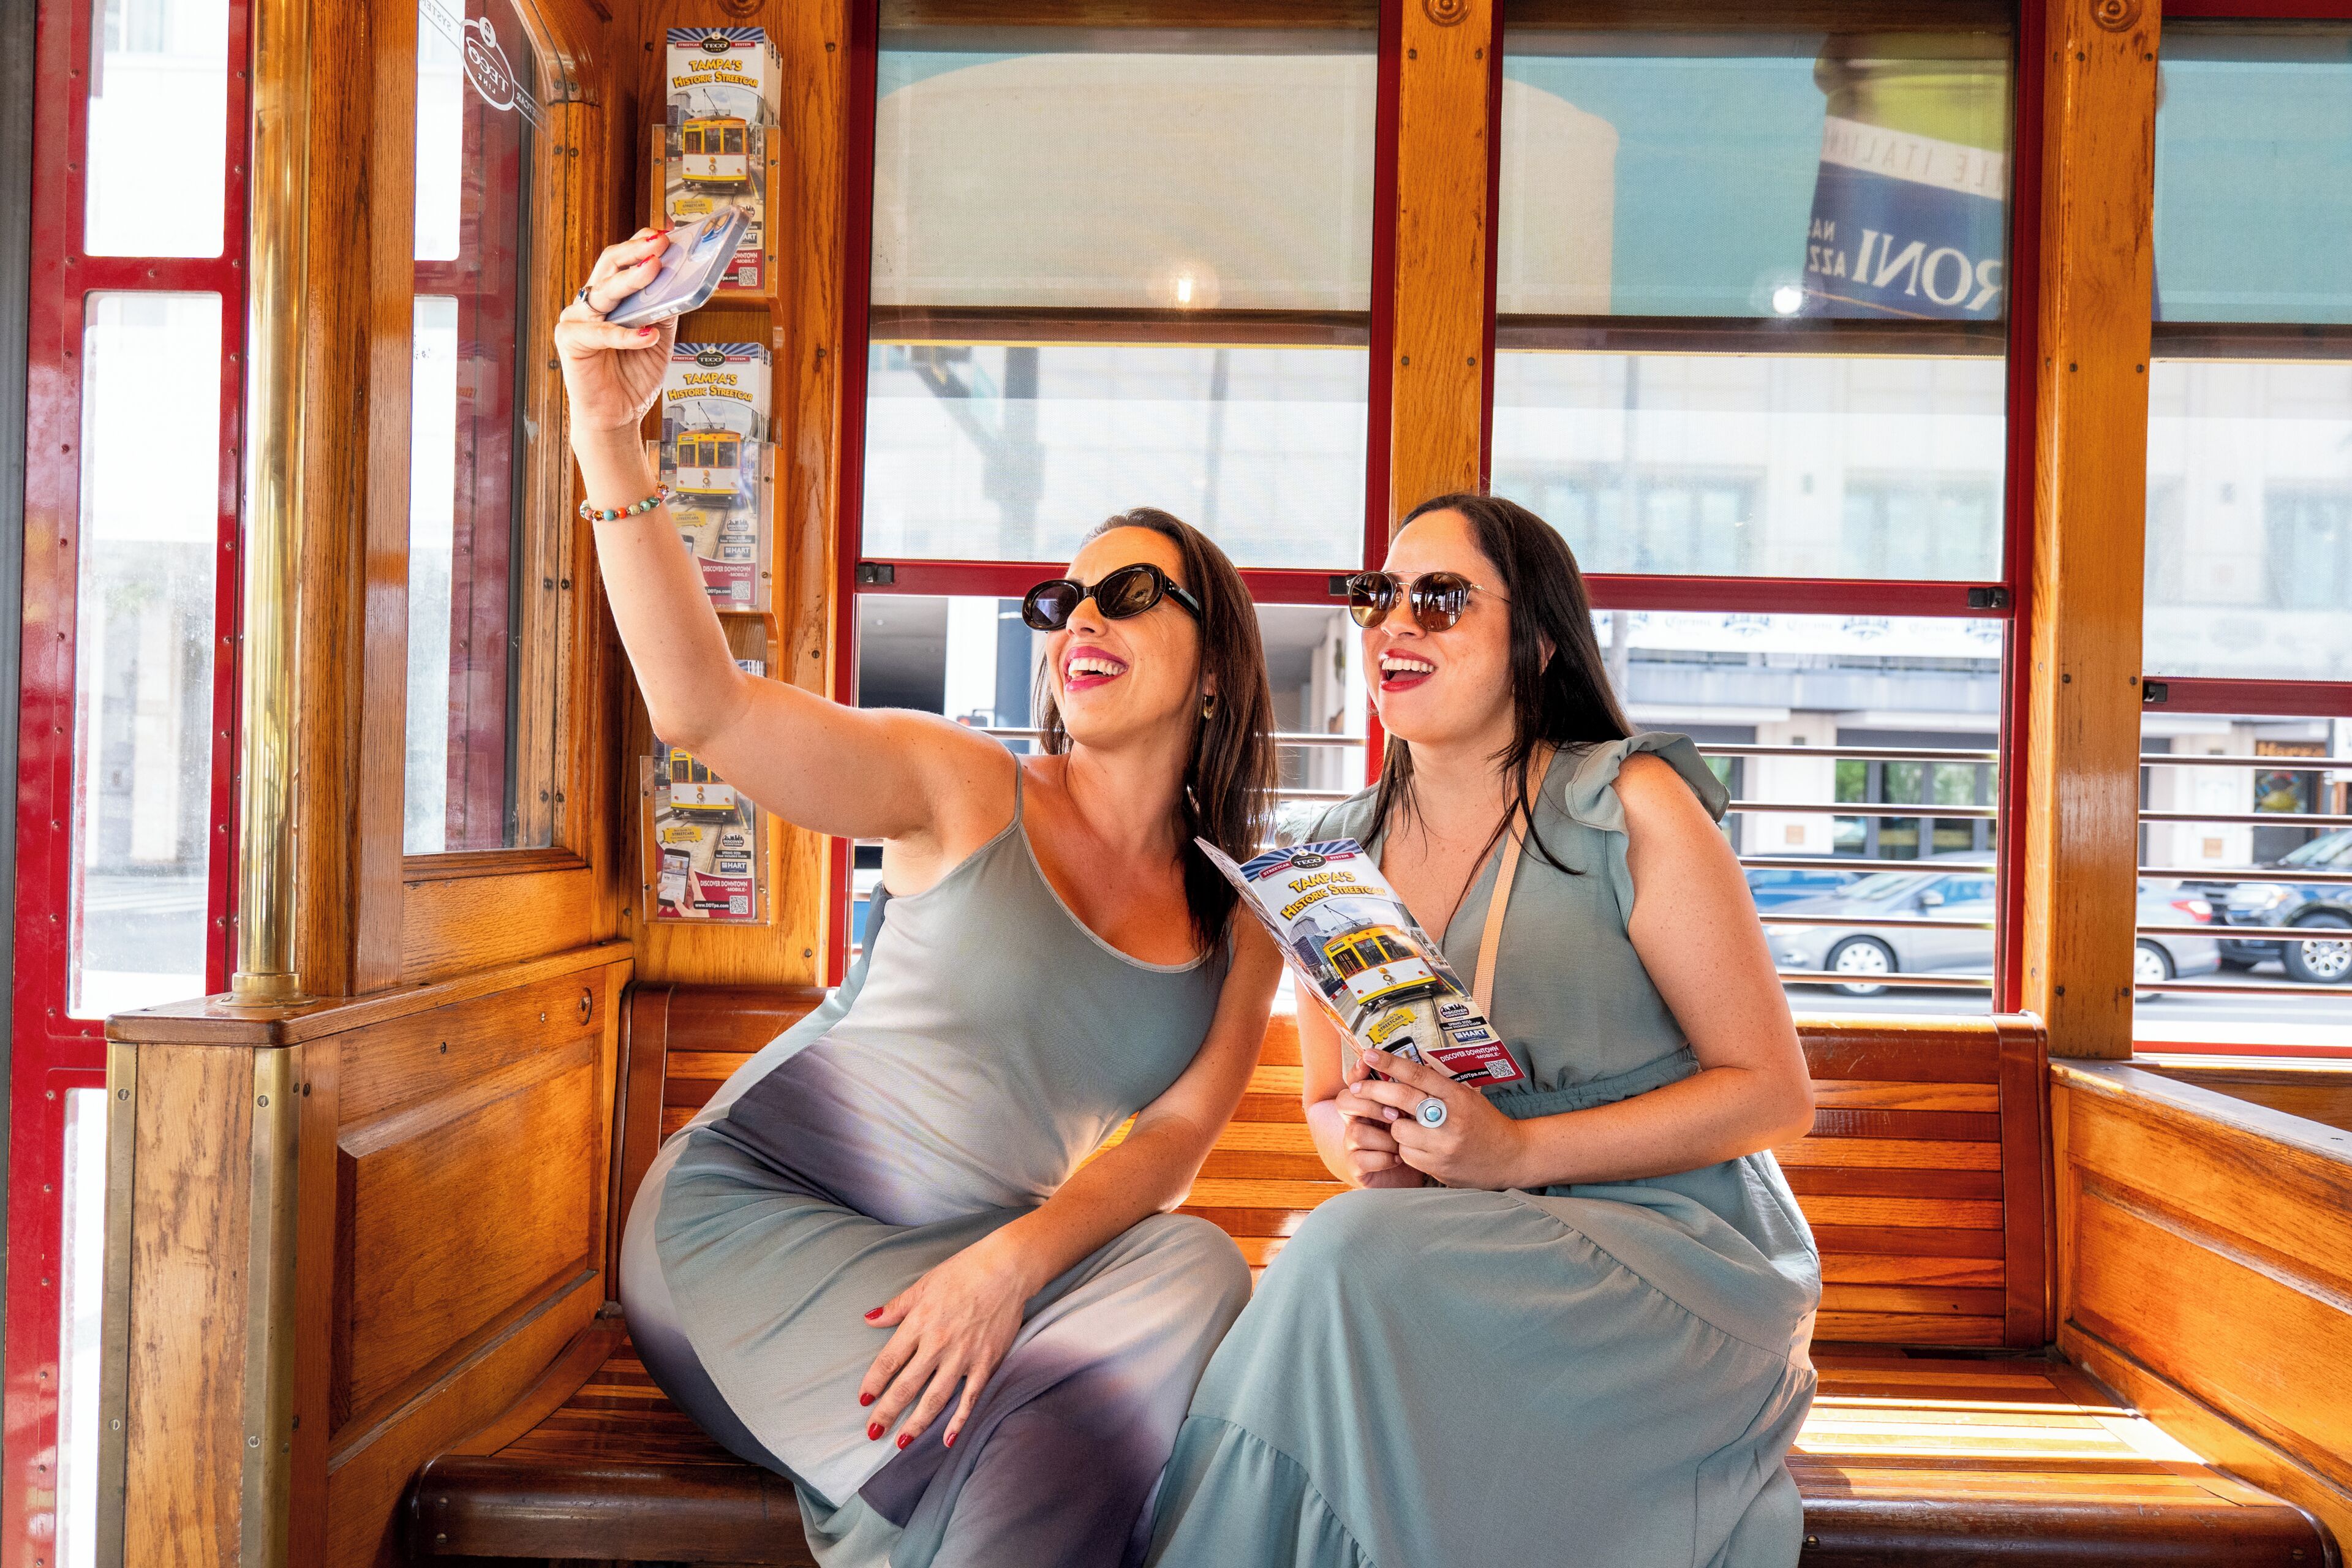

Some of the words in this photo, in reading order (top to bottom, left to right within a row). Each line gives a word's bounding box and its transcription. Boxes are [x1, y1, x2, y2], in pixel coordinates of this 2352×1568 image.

[688, 58, 742, 72] TAMPA'S
[683, 372, 738, 385] TAMPA'S
[1263, 862, 1291, 876] STREETCAR
[1294, 857, 1322, 866] TECO
[1288, 871, 1357, 894] TAMPA'S
[1378, 1014, 1404, 1032] STREETCARS
[1463, 1029, 1485, 1038] HART
[1440, 1050, 1466, 1063] DISCOVER
[1465, 1046, 1499, 1056] DOWNTOWN
[1454, 1070, 1489, 1082] w.DDTpa.com
